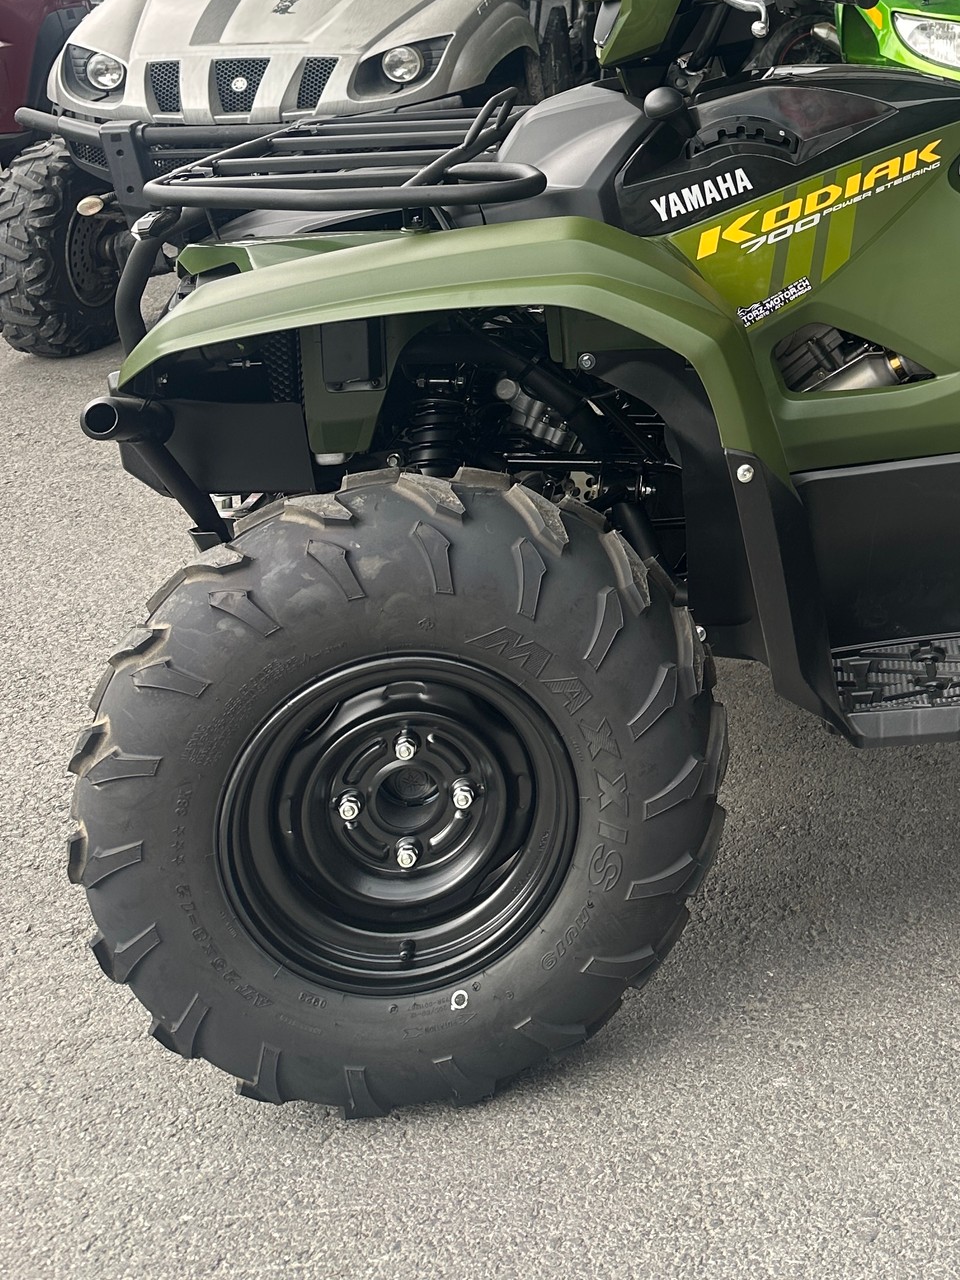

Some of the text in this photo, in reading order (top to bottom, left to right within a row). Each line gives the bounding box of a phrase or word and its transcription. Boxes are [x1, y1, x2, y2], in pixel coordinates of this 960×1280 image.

[650, 167, 754, 222] YAMAHA
[696, 139, 943, 261] KODIAK
[740, 161, 941, 255] 700 POWER STEERING
[463, 624, 631, 893] MAXXIS
